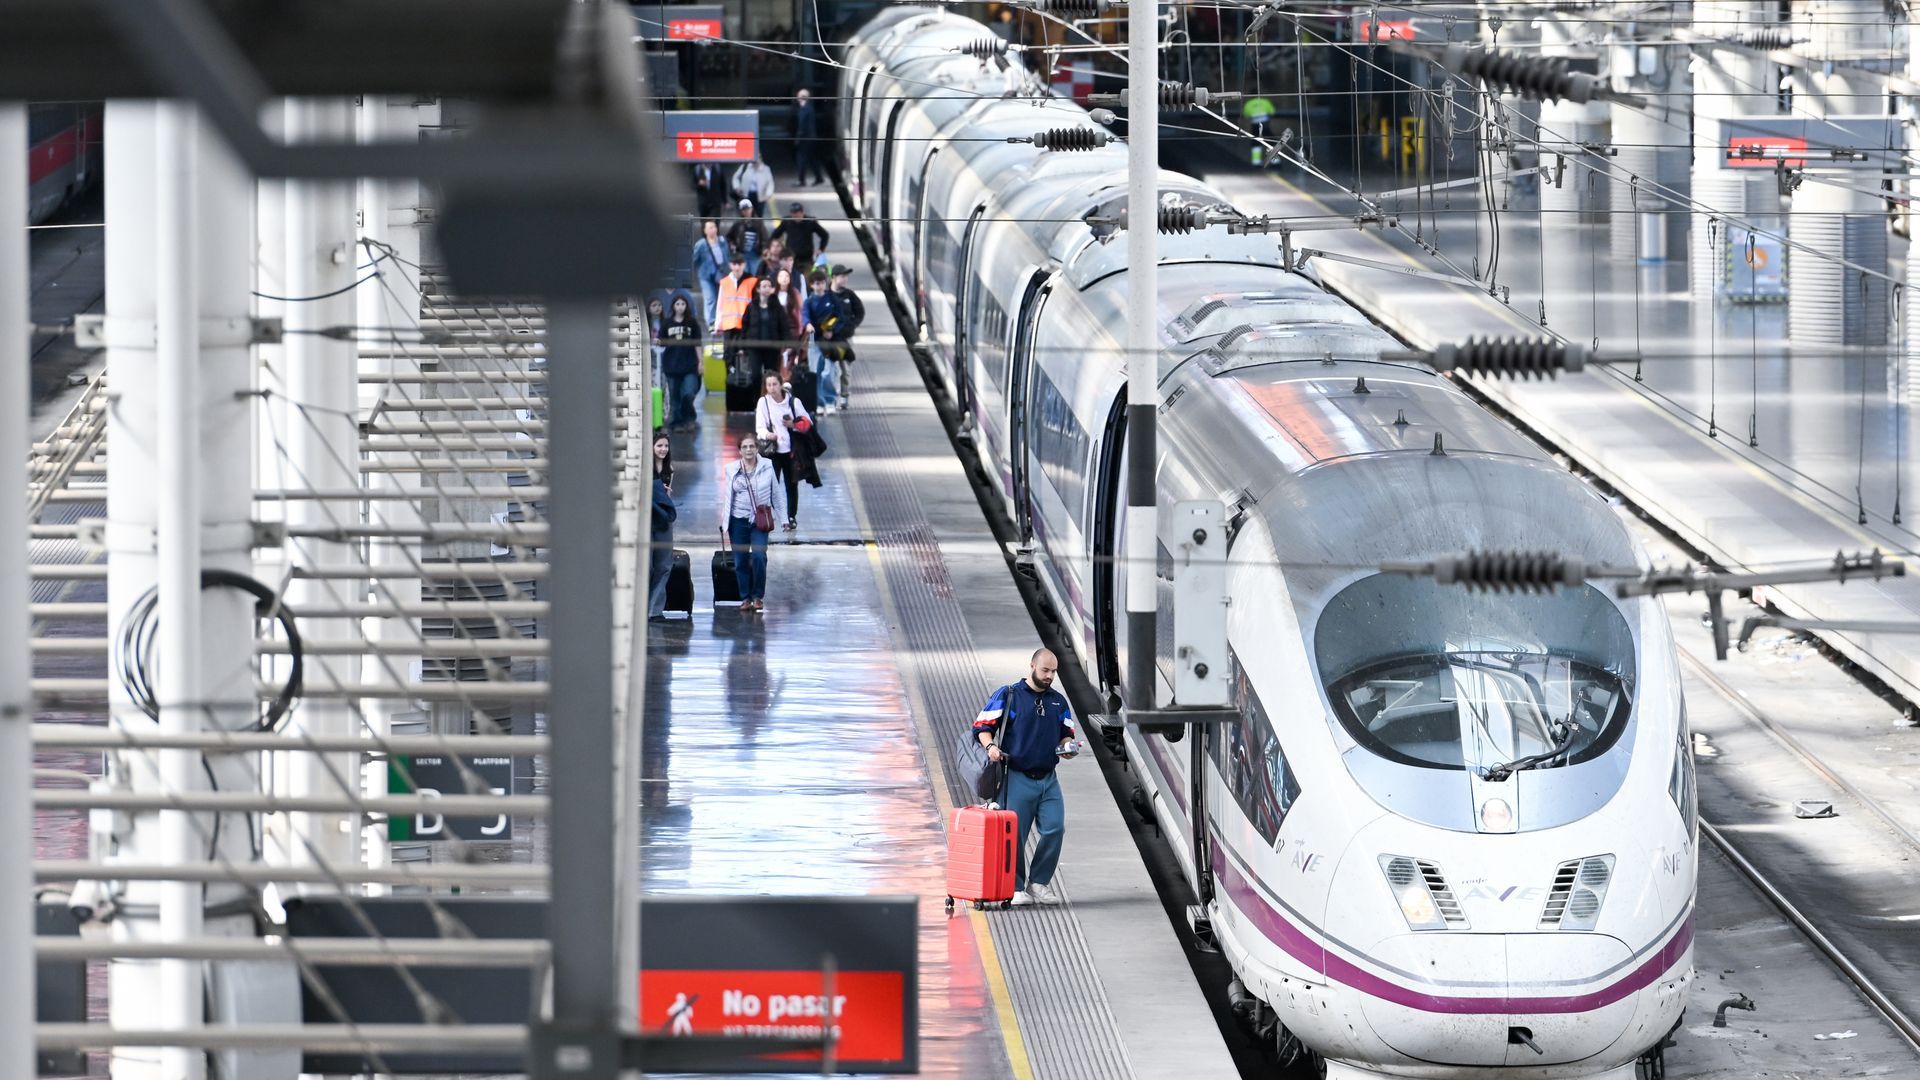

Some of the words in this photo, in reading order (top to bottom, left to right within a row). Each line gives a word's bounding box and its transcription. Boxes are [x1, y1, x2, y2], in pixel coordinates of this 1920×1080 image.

[416, 758, 442, 766] SECTOR
[473, 758, 510, 766] PLATFORM
[1291, 850, 1325, 874] AVE
[1462, 886, 1546, 902] AVE
[722, 989, 761, 1017] No
